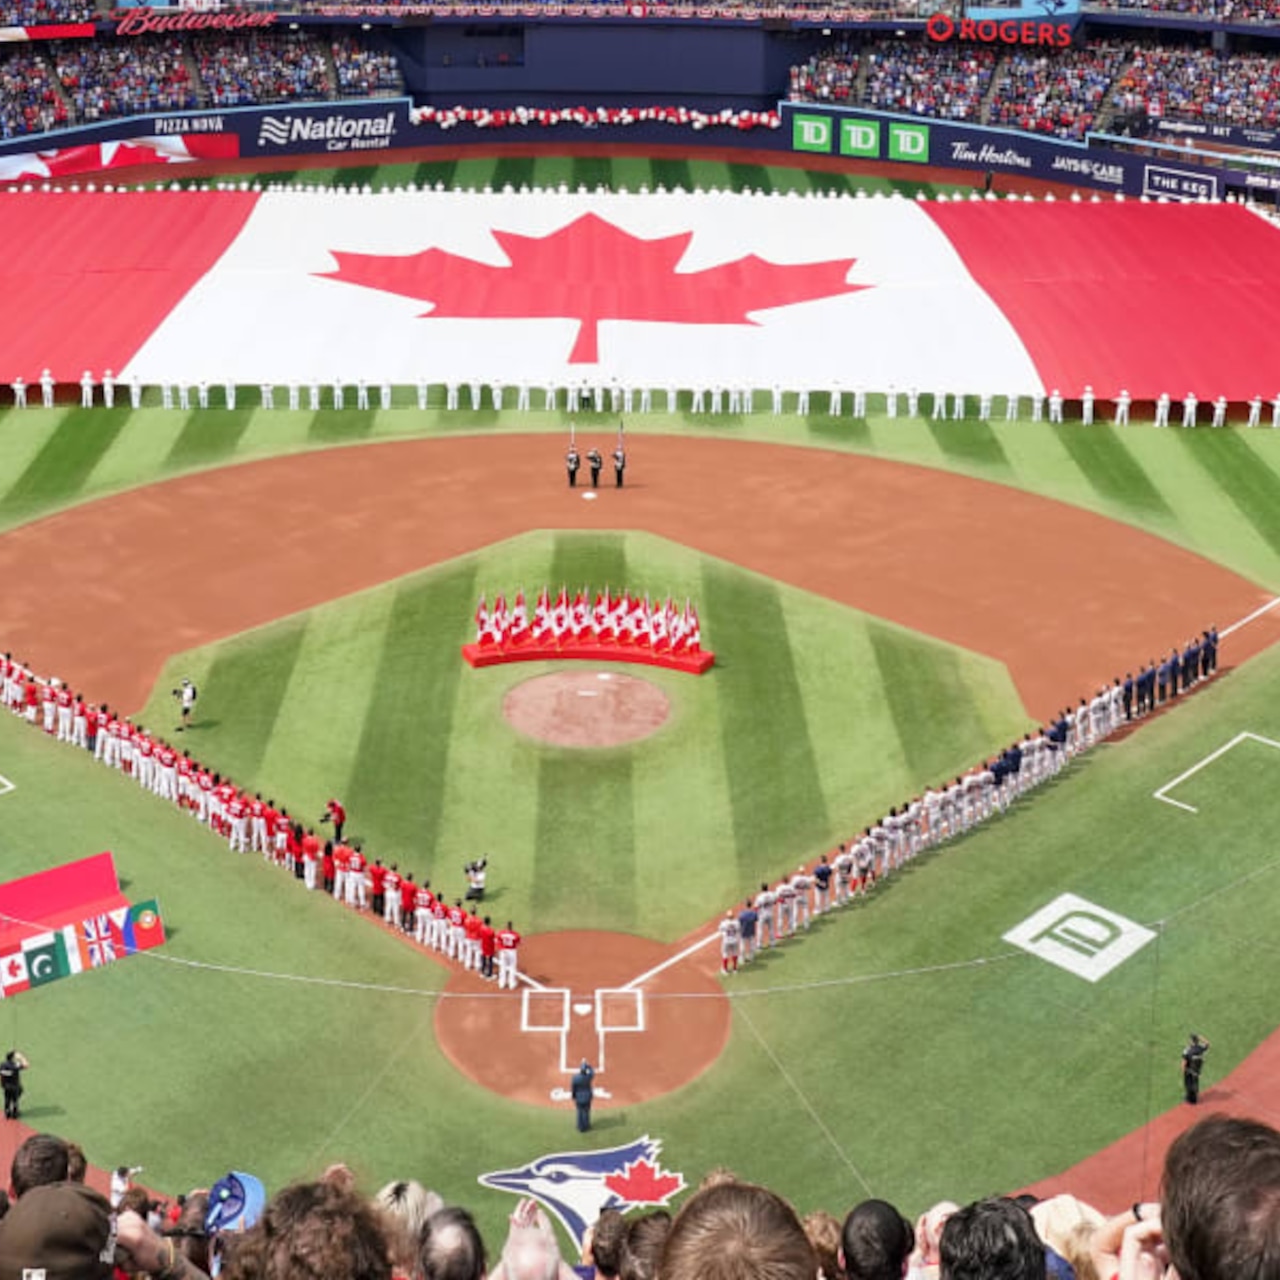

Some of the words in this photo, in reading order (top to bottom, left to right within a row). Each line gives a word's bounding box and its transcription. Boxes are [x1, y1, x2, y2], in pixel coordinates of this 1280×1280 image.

[109, 6, 279, 36] Budweiser
[960, 18, 1073, 47] ROGERS
[154, 117, 190, 135] PIZZA
[191, 115, 224, 132] NOVA
[290, 112, 394, 141] National
[798, 120, 828, 145] TD
[845, 125, 877, 150] TD
[326, 138, 349, 151] Car
[350, 136, 391, 149] Rental
[893, 129, 925, 155] TD
[950, 141, 978, 162] Tim
[978, 143, 1032, 168] Hortons
[1152, 175, 1179, 189] THE
[1181, 179, 1209, 195] KEG
[1028, 909, 1124, 959] TD
